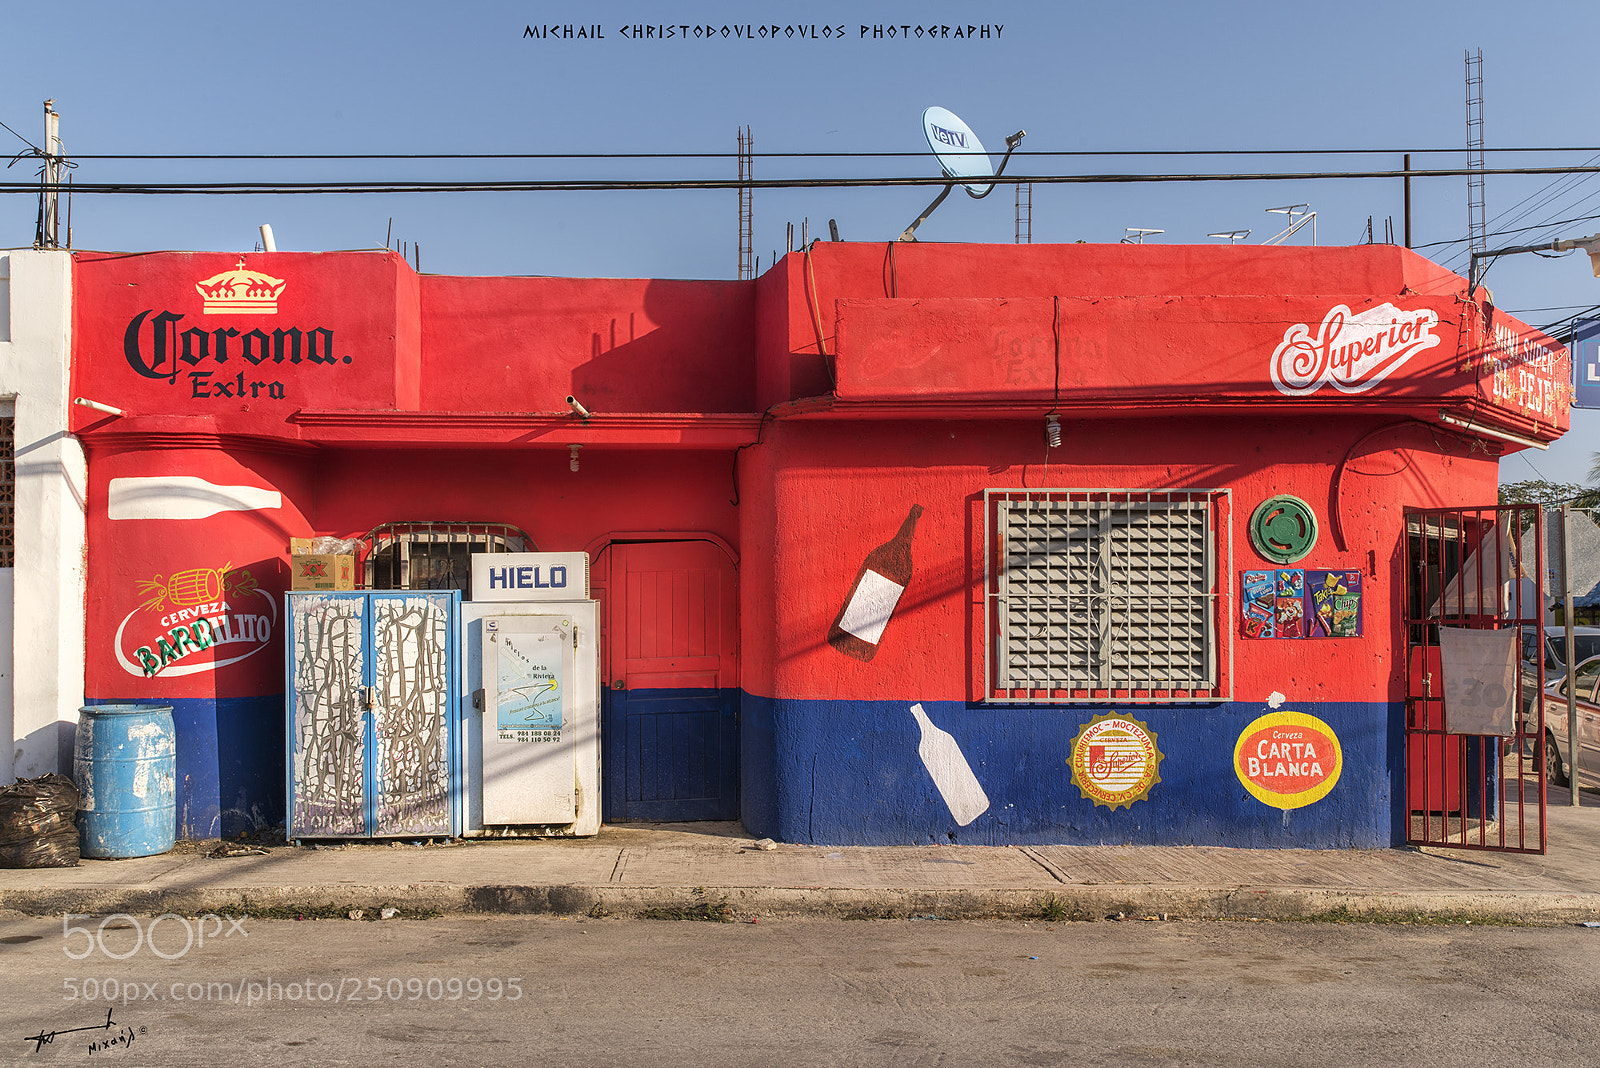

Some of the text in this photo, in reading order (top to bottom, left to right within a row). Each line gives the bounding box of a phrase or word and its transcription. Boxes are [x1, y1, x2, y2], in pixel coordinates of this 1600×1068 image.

[931, 124, 966, 148] VeTV
[1276, 311, 1430, 390] Superior
[1523, 338, 1554, 375] SUPER
[188, 371, 286, 399] Extra
[489, 564, 567, 589] HIELO
[161, 602, 231, 626] CERVEZA
[1272, 730, 1303, 740] Cerveza
[1075, 724, 1104, 769] CUAUHTEMOC
[1112, 720, 1154, 760] MOCTEZUMA
[1134, 781, 1146, 793] DE
[1257, 739, 1317, 762] CARTA
[1247, 757, 1323, 777] BLANCA
